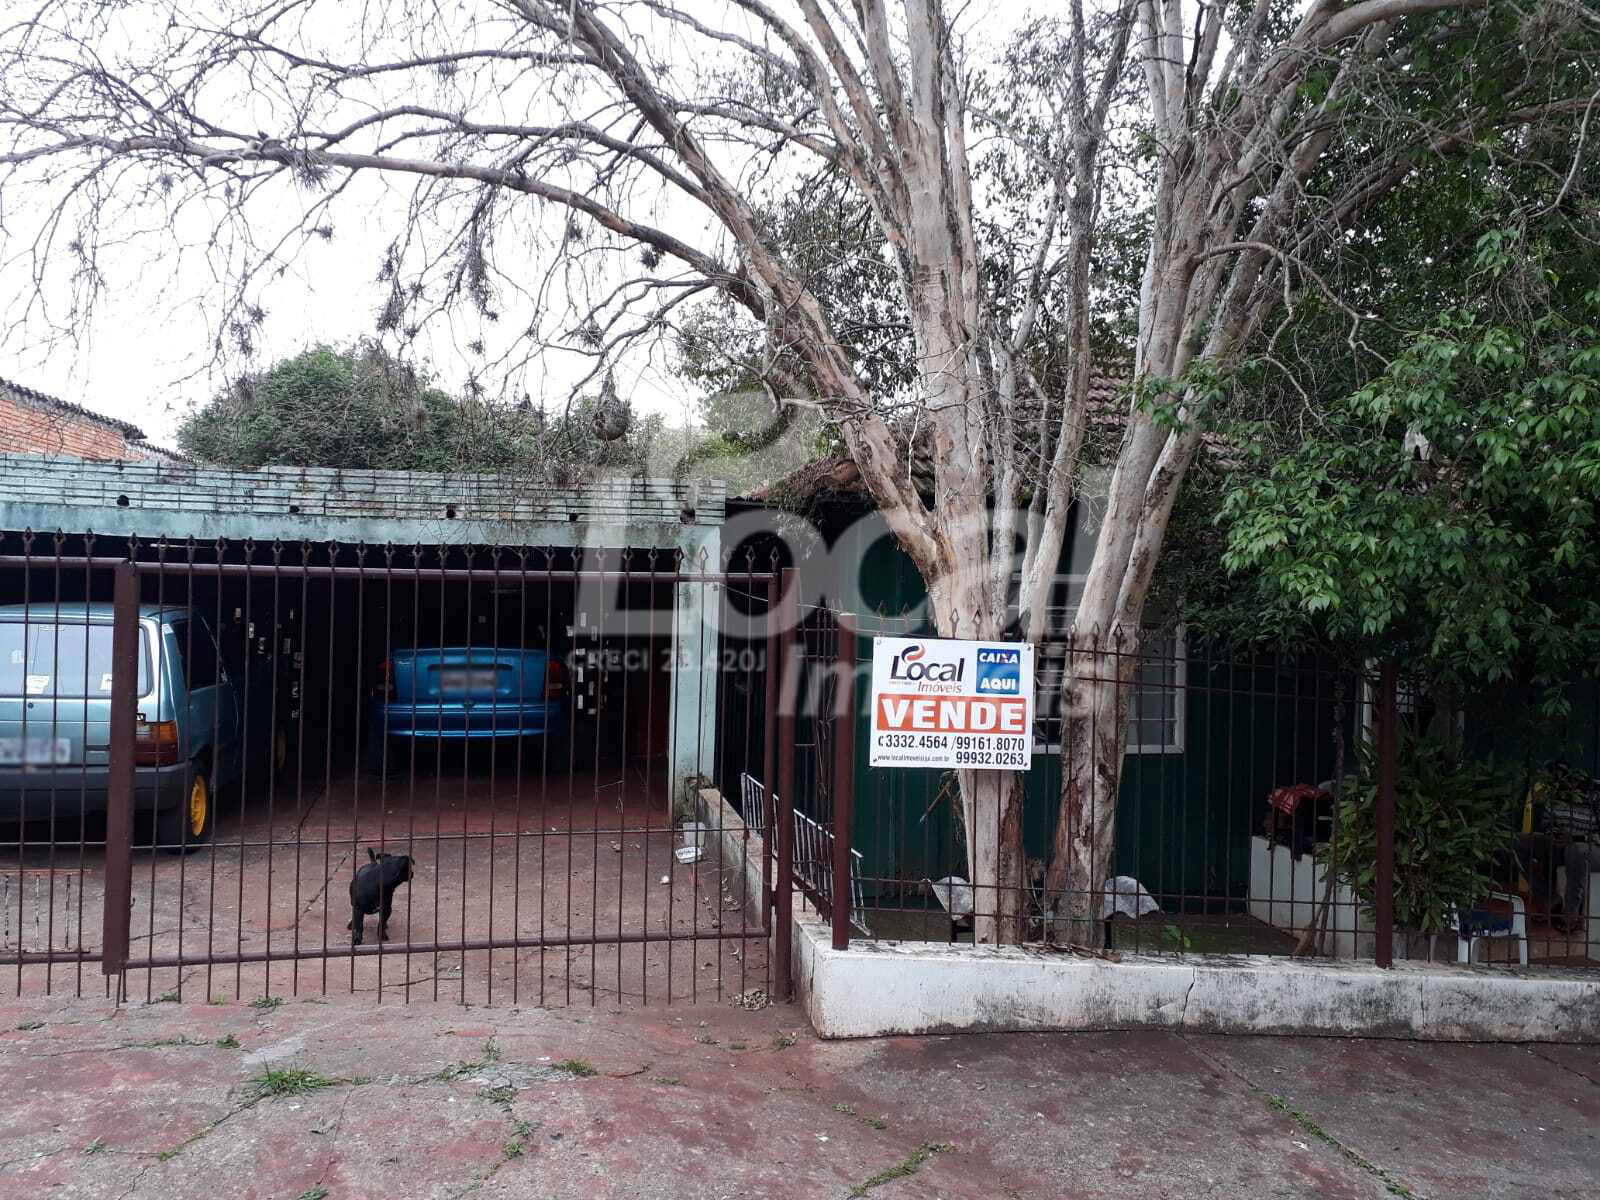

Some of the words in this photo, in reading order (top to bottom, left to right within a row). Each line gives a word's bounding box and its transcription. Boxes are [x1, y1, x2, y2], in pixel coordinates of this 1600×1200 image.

[979, 652, 1018, 664] CAIXA
[890, 655, 965, 682] Local
[917, 681, 962, 694] Imóveis
[980, 677, 1016, 690] AQUI
[881, 698, 1024, 731] VENDE
[885, 734, 948, 749] 3332.4564
[956, 752, 1024, 766] 99932.0263
